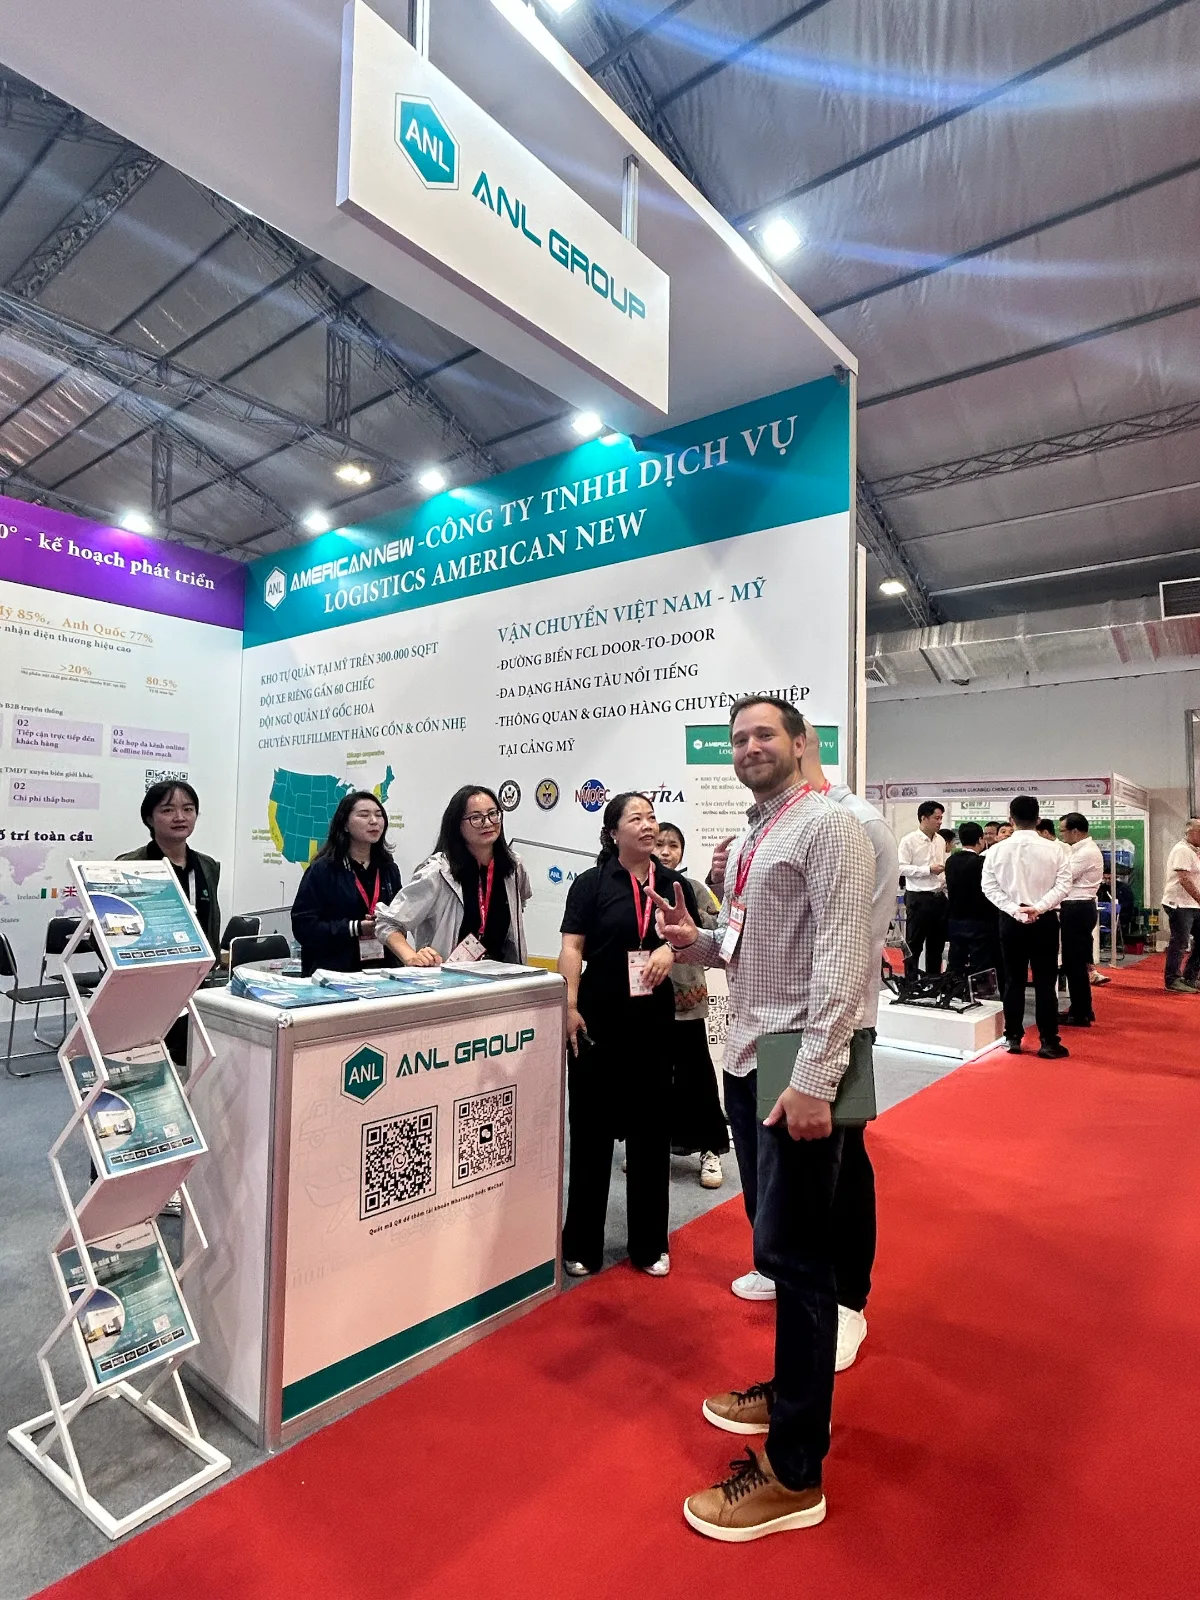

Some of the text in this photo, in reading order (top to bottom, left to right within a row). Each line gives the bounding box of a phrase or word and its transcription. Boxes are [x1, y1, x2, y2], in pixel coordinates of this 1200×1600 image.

[405, 118, 450, 173] ANL
[471, 170, 646, 320] ANL GROUP
[500, 495, 534, 528] TY
[541, 466, 629, 516] TNHH
[638, 436, 729, 488] DỊCH
[740, 415, 798, 456] VỤ
[38, 532, 64, 552] kế
[67, 540, 126, 568] hoạch
[130, 558, 170, 578] phát
[174, 569, 216, 590] triển
[324, 508, 648, 614] LOGISTICS AMERICAN NEW
[268, 581, 283, 597] ANL
[498, 622, 532, 644] VẬN
[535, 604, 609, 636] CHUYỂN
[613, 599, 659, 624] VIỆT
[662, 589, 712, 615] NAM
[730, 576, 768, 603] MỸ
[4, 625, 30, 636] nhận
[33, 630, 56, 640] diện
[58, 634, 92, 648] thương
[94, 640, 114, 650] hiệu
[62, 618, 90, 632] Anh
[93, 623, 127, 638] Quốc
[130, 630, 154, 644] 77%
[544, 646, 574, 664] BIỂN
[576, 646, 598, 660] FCL
[602, 627, 716, 656] DOOR-TO-DOOR
[60, 664, 92, 676] >20%
[260, 642, 439, 686] KHO TỰ QUẢN TẠI MỸ TRÊN 300.000 SQFT
[146, 676, 178, 689] 80.5%
[260, 694, 275, 708] ĐỘI
[276, 693, 286, 704] XE
[288, 688, 313, 703] RIÊNG
[334, 684, 344, 695] 60
[345, 674, 375, 692] CHIẾC
[518, 682, 552, 698] DẠNG
[594, 672, 622, 688] TÀU
[654, 662, 699, 682] TIẾNG
[17, 718, 29, 727] 02
[260, 715, 274, 730] ĐỘI
[294, 708, 318, 725] QUẢN
[332, 702, 352, 718] GỐC
[354, 702, 375, 716] HOA
[542, 708, 578, 725] QUAN
[580, 708, 590, 720] &
[592, 704, 627, 719] GIAO
[630, 700, 672, 716] HÀNG
[674, 692, 740, 712] CHUYÊN
[16, 738, 59, 748] khách hàng
[113, 729, 124, 737] 03
[292, 729, 350, 746] FULFILLMENT
[351, 726, 380, 740] HÀNG
[405, 722, 414, 734] &
[442, 716, 467, 732] NHẸ
[498, 738, 576, 758] TẠI CẢNG MỸ
[13, 782, 26, 790] 02
[10, 830, 30, 841] trí
[34, 830, 66, 842] toàn
[396, 1028, 536, 1078] ANL GROUP
[348, 1063, 380, 1086] ANL
